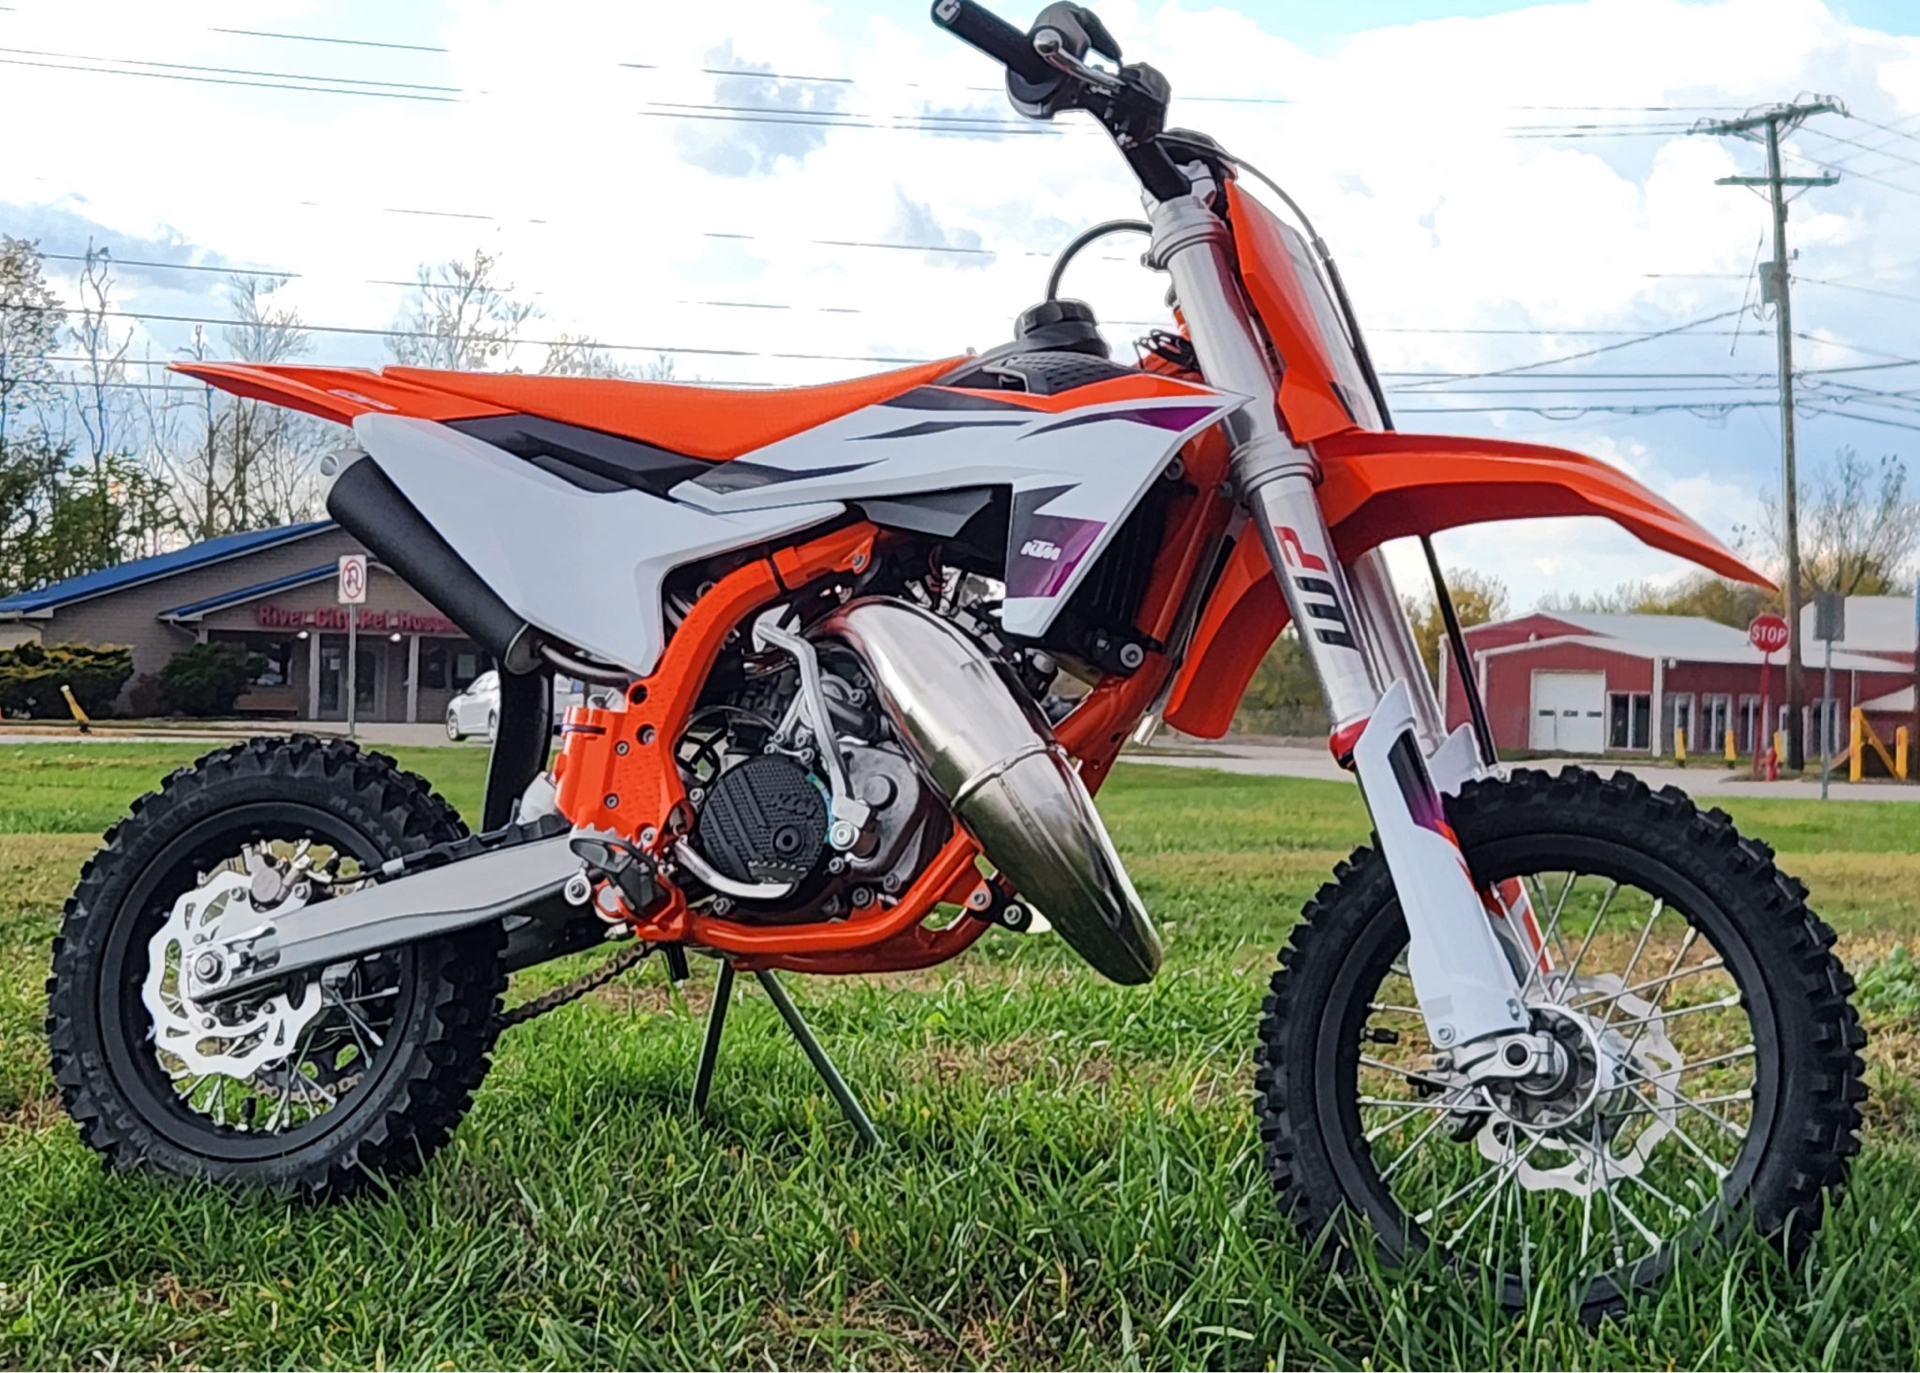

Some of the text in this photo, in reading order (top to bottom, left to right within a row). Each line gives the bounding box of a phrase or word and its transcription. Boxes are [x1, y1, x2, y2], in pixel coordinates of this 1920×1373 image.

[1021, 539, 1062, 561] KTM
[258, 605, 306, 627] River
[315, 607, 350, 632] City
[359, 609, 391, 629] Pet
[1751, 624, 1787, 643] STOP
